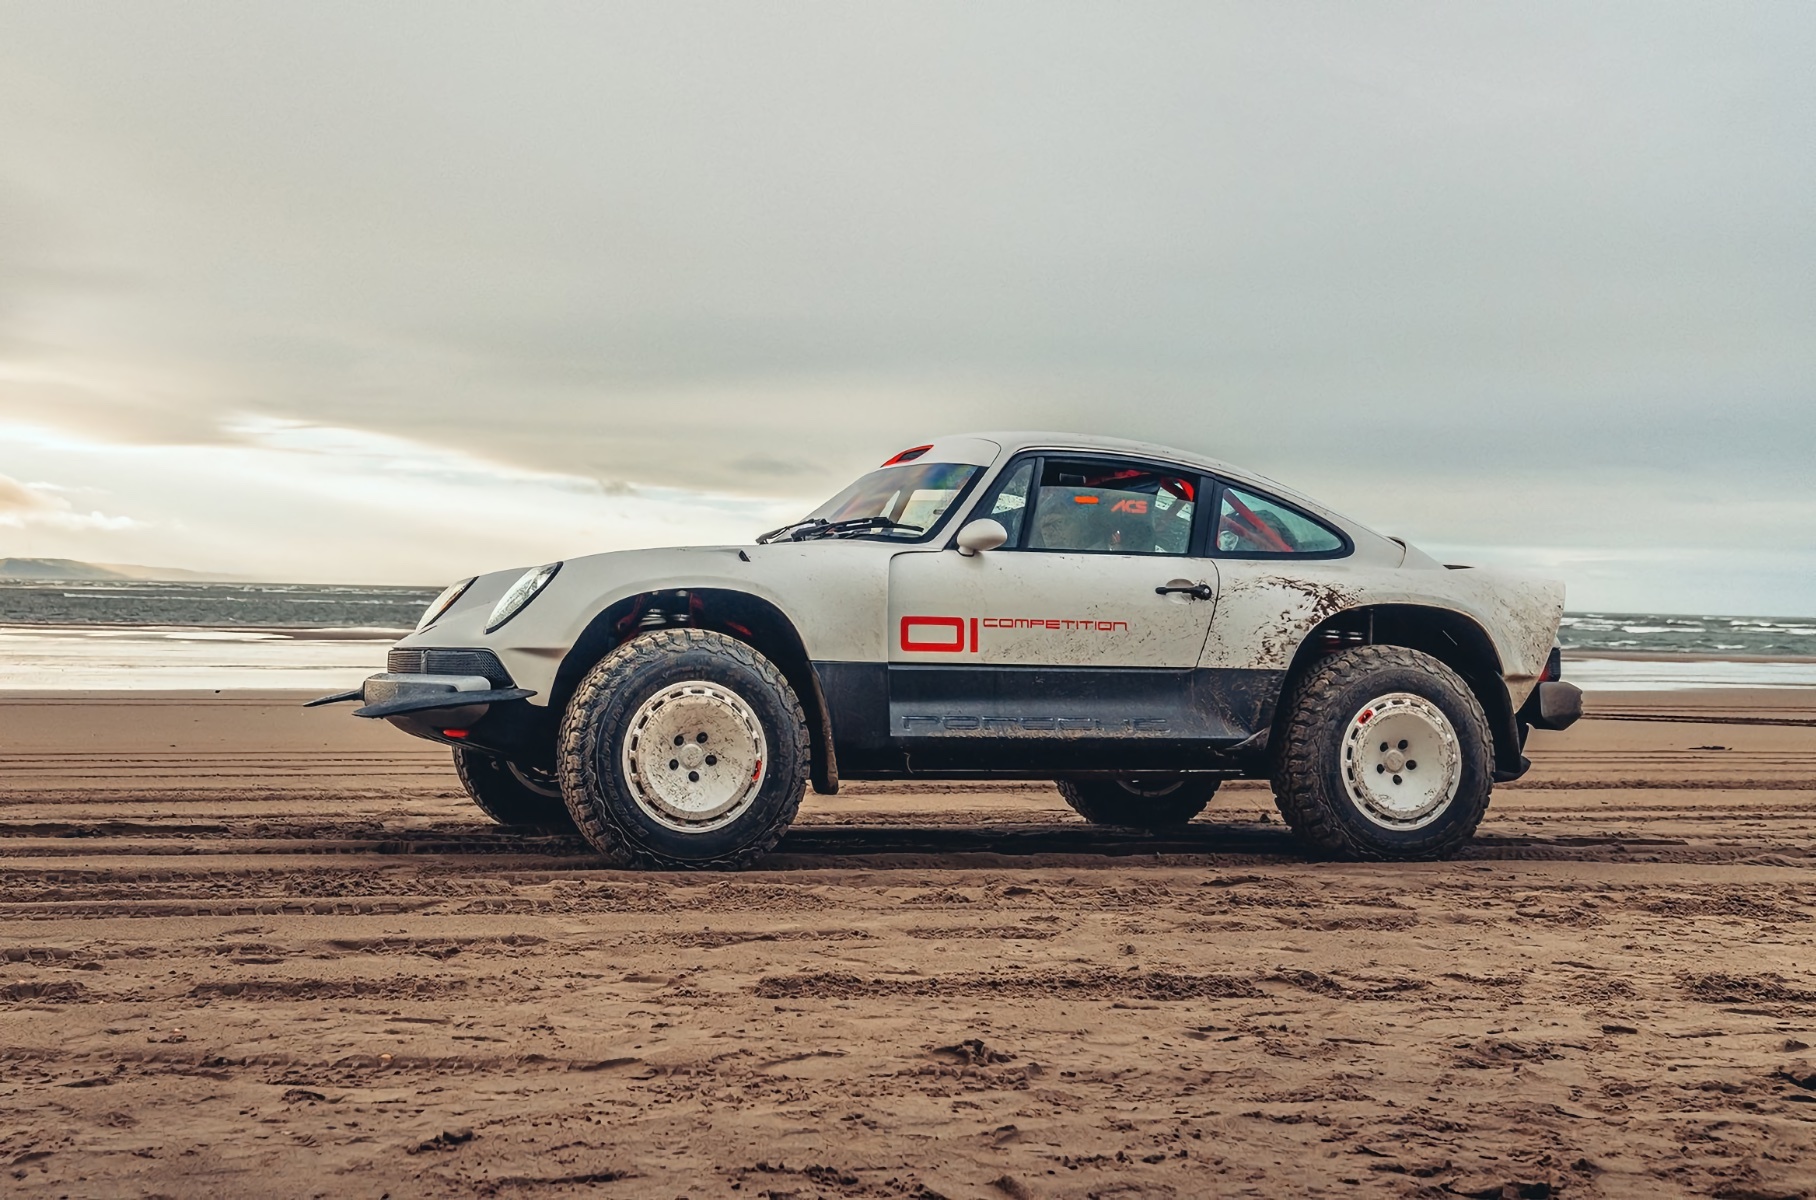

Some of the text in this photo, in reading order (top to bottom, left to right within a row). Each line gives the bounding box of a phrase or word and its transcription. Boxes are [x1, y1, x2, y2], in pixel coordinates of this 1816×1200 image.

[1110, 499, 1148, 514] ACS
[900, 616, 1128, 653] 01 COMPETITION
